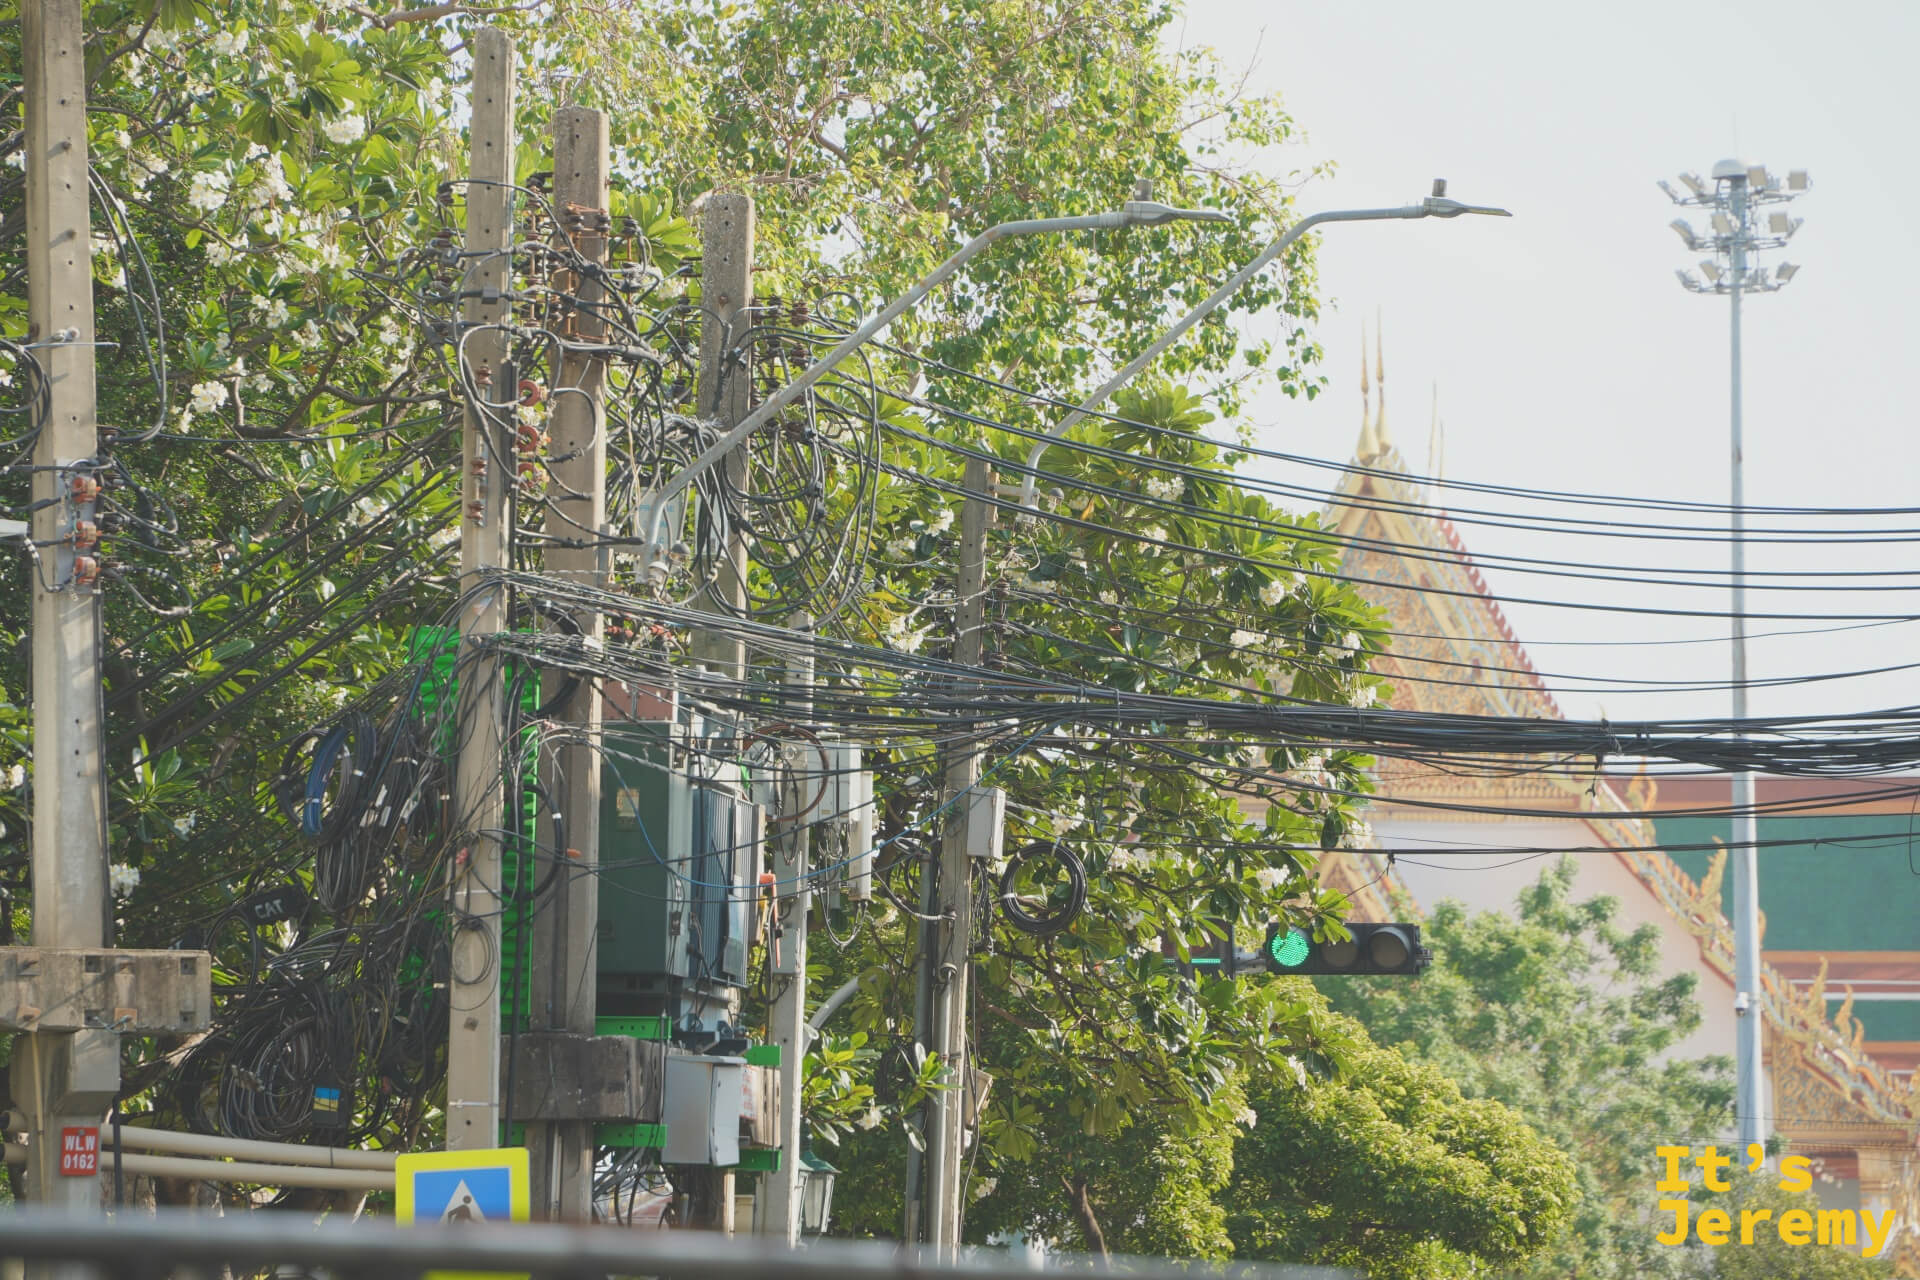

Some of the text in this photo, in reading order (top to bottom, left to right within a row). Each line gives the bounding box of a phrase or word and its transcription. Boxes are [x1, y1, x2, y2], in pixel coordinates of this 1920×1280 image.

[254, 899, 284, 919] CAT
[64, 1135, 96, 1151] WLW
[63, 1154, 95, 1169] 0162
